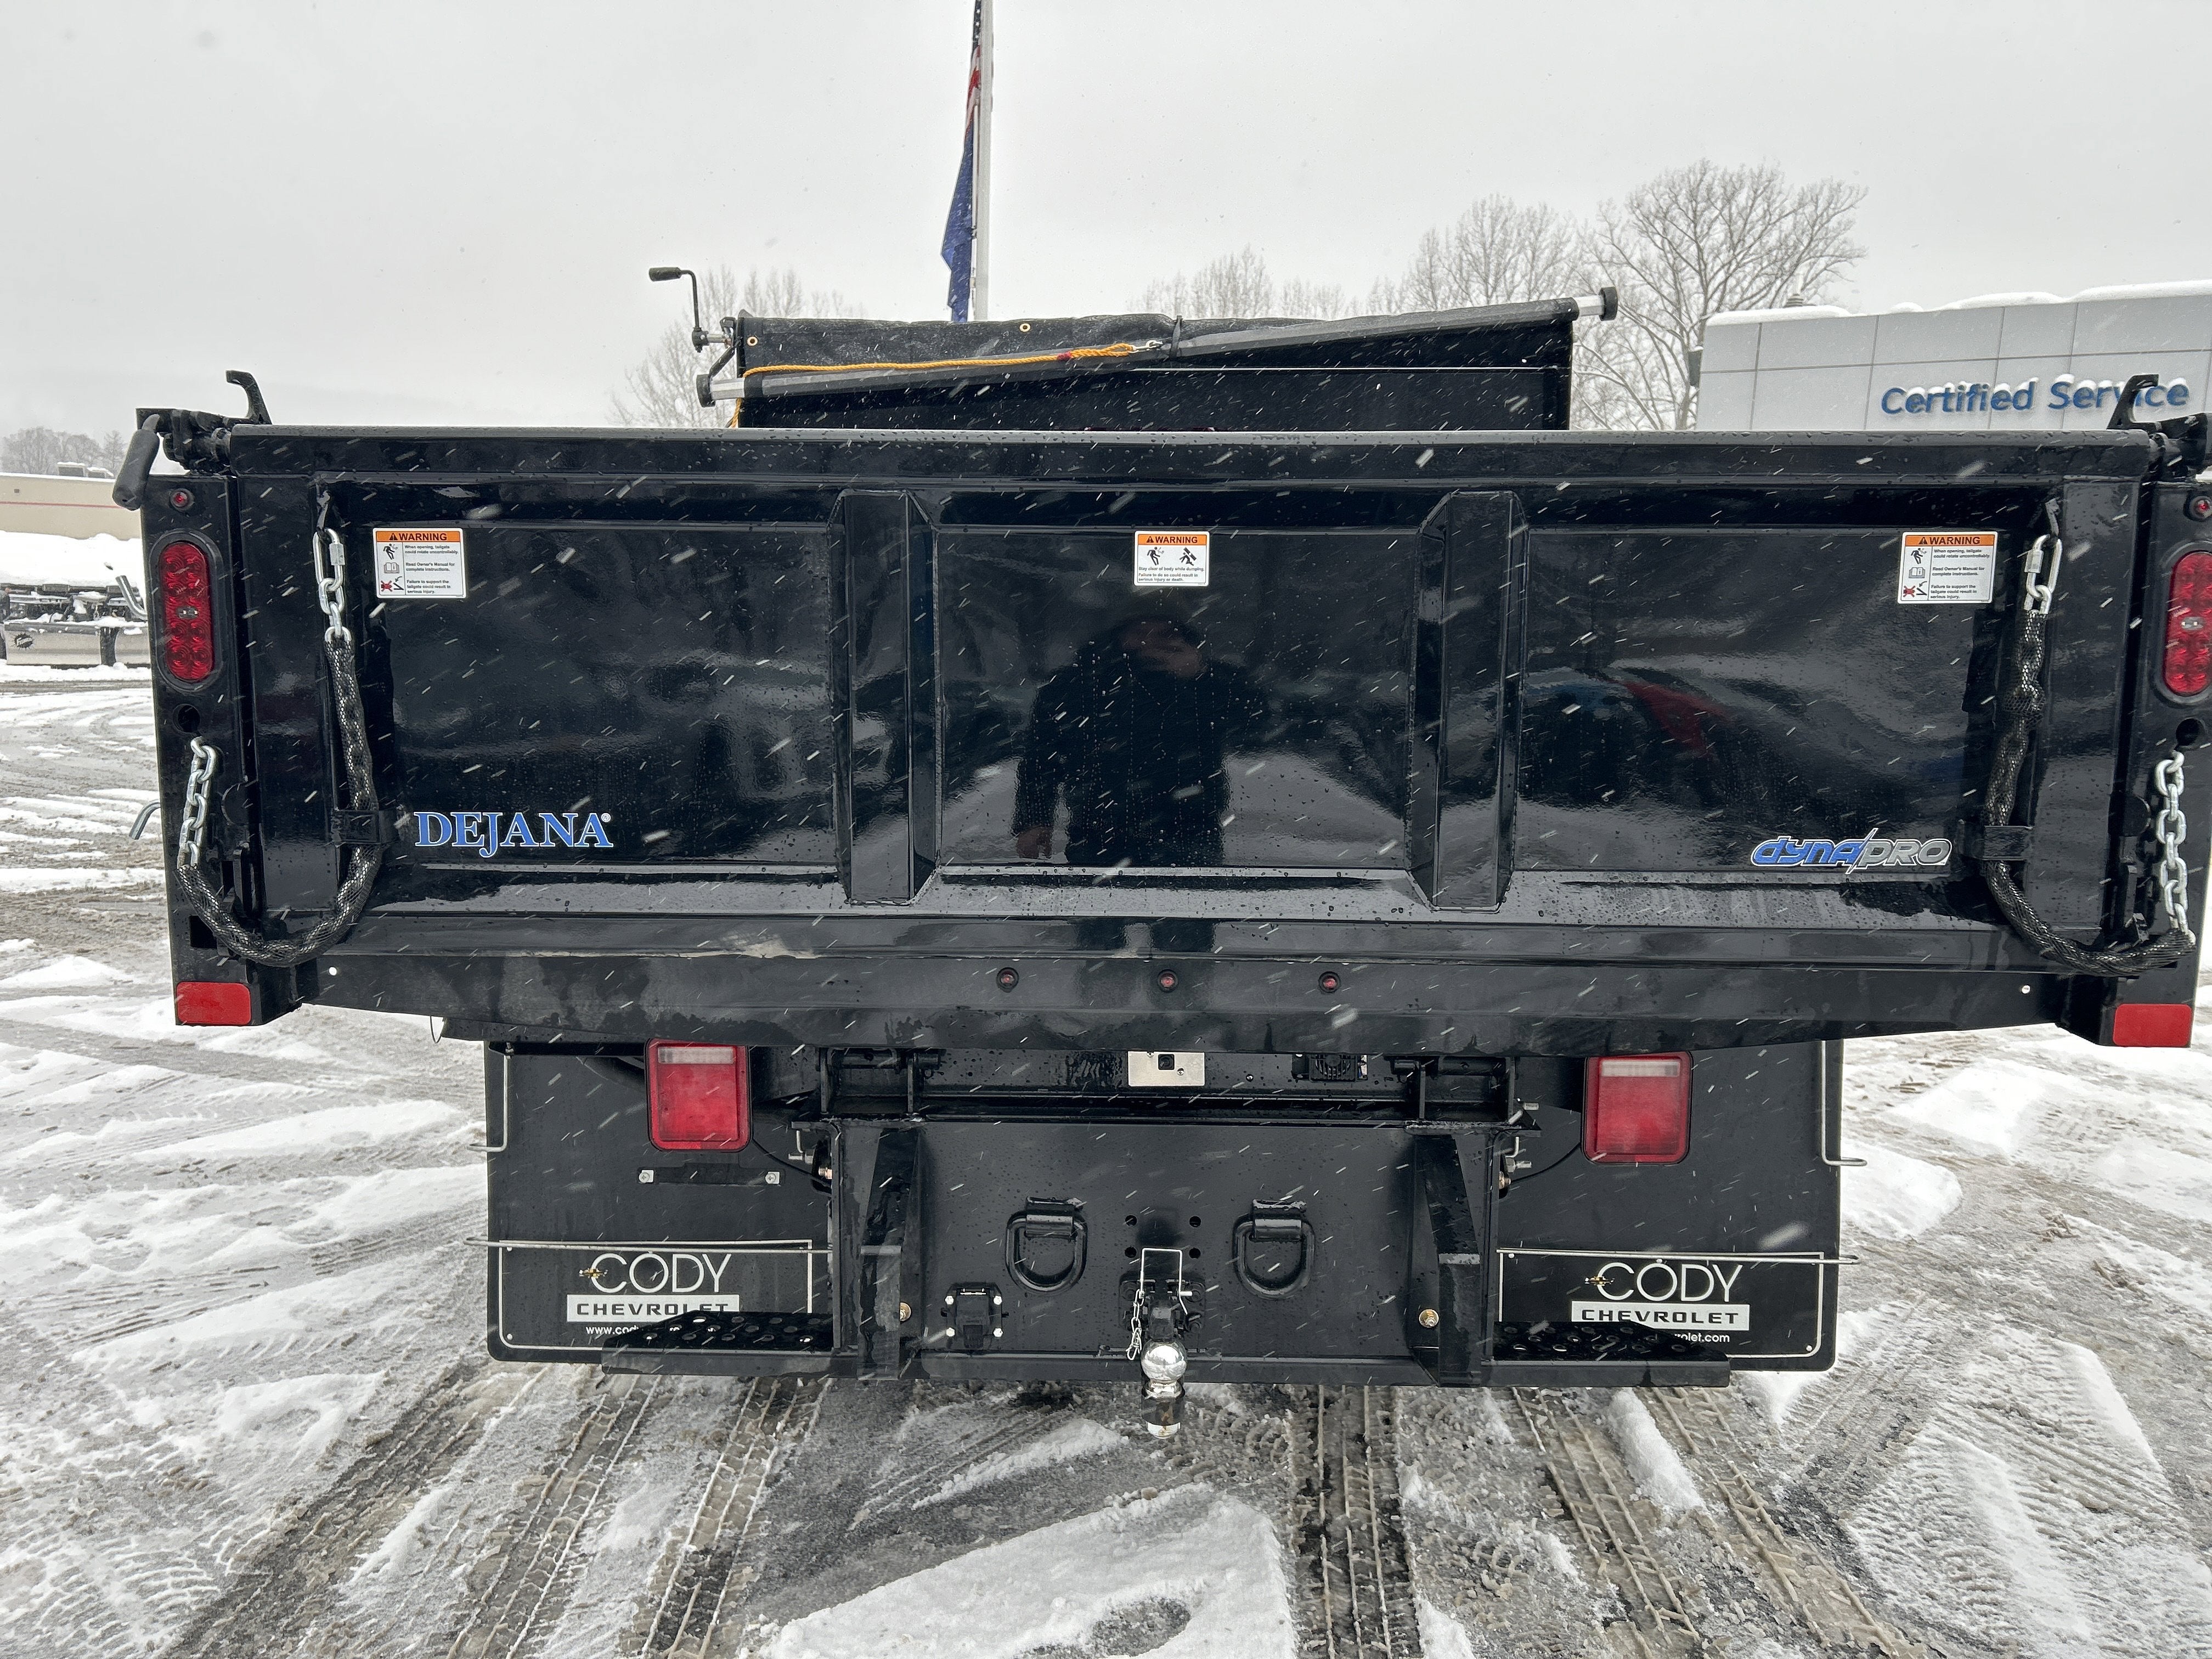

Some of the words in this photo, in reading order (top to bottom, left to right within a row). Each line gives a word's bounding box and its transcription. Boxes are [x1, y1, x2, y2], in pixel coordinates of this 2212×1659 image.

[1881, 380, 2037, 414] Certified
[398, 533, 447, 541] WARNING
[1930, 537, 1980, 545] WARNING
[591, 1253, 732, 1293] CODY
[1596, 1262, 1743, 1302] CODY
[577, 1303, 729, 1315] CHEVROLET
[1582, 1309, 1739, 1324] CHEVROLET
[585, 1324, 639, 1335] www.cod
[1674, 1332, 1730, 1342] olet.com
